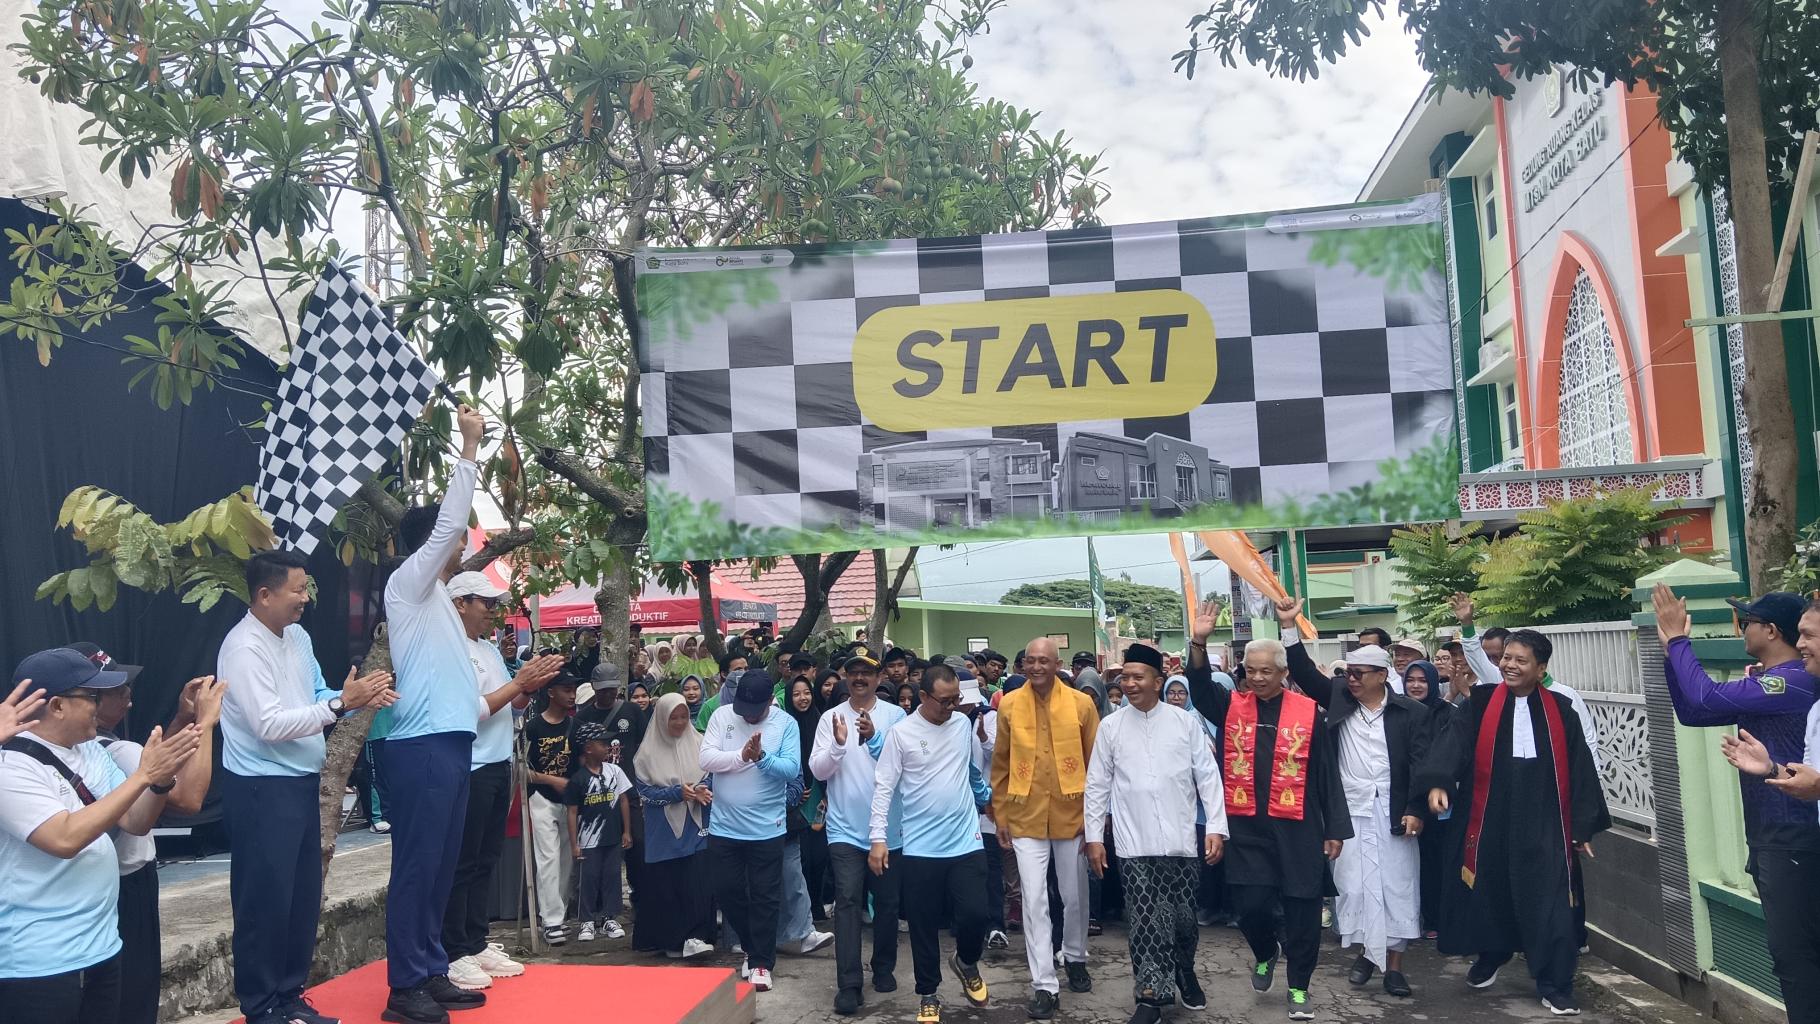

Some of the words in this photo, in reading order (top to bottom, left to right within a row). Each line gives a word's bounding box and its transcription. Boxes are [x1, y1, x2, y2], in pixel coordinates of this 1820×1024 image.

[1521, 146, 1549, 184] GEDUNG
[1547, 119, 1574, 159] RUANG
[1571, 88, 1602, 132] KELAS
[1548, 149, 1576, 190] KOTA
[1576, 116, 1608, 162] BATU
[892, 313, 1189, 398] START
